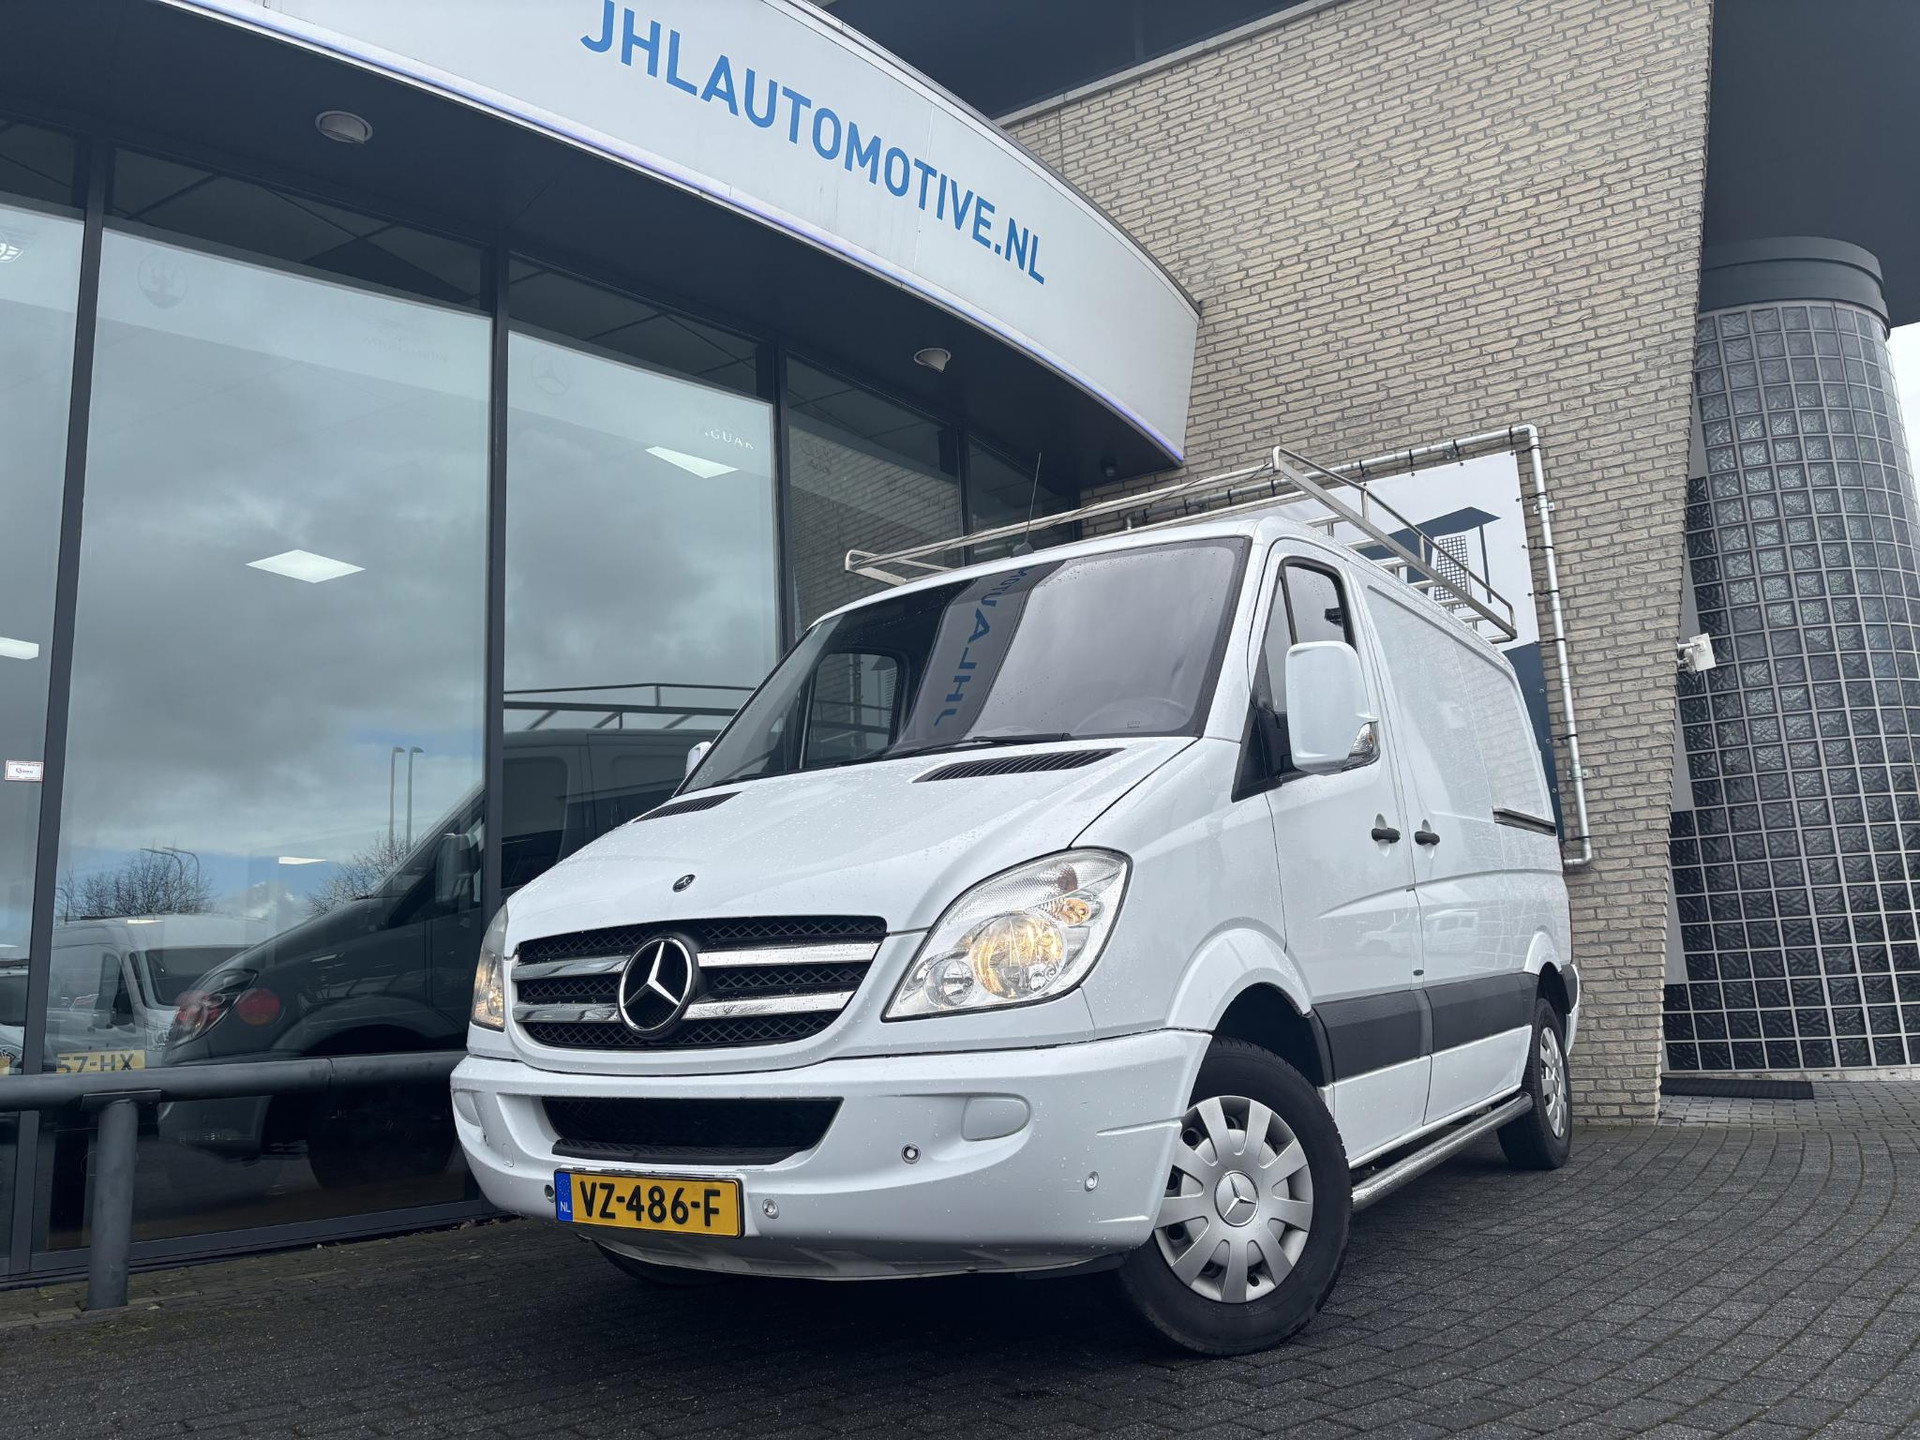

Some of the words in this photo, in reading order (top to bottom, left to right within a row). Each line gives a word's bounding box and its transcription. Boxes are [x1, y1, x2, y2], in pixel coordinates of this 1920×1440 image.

[580, 0, 1045, 285] JHLAUTOMOTIVE.NL
[560, 1202, 571, 1213] NL
[580, 1181, 721, 1227] VZ-486-F
